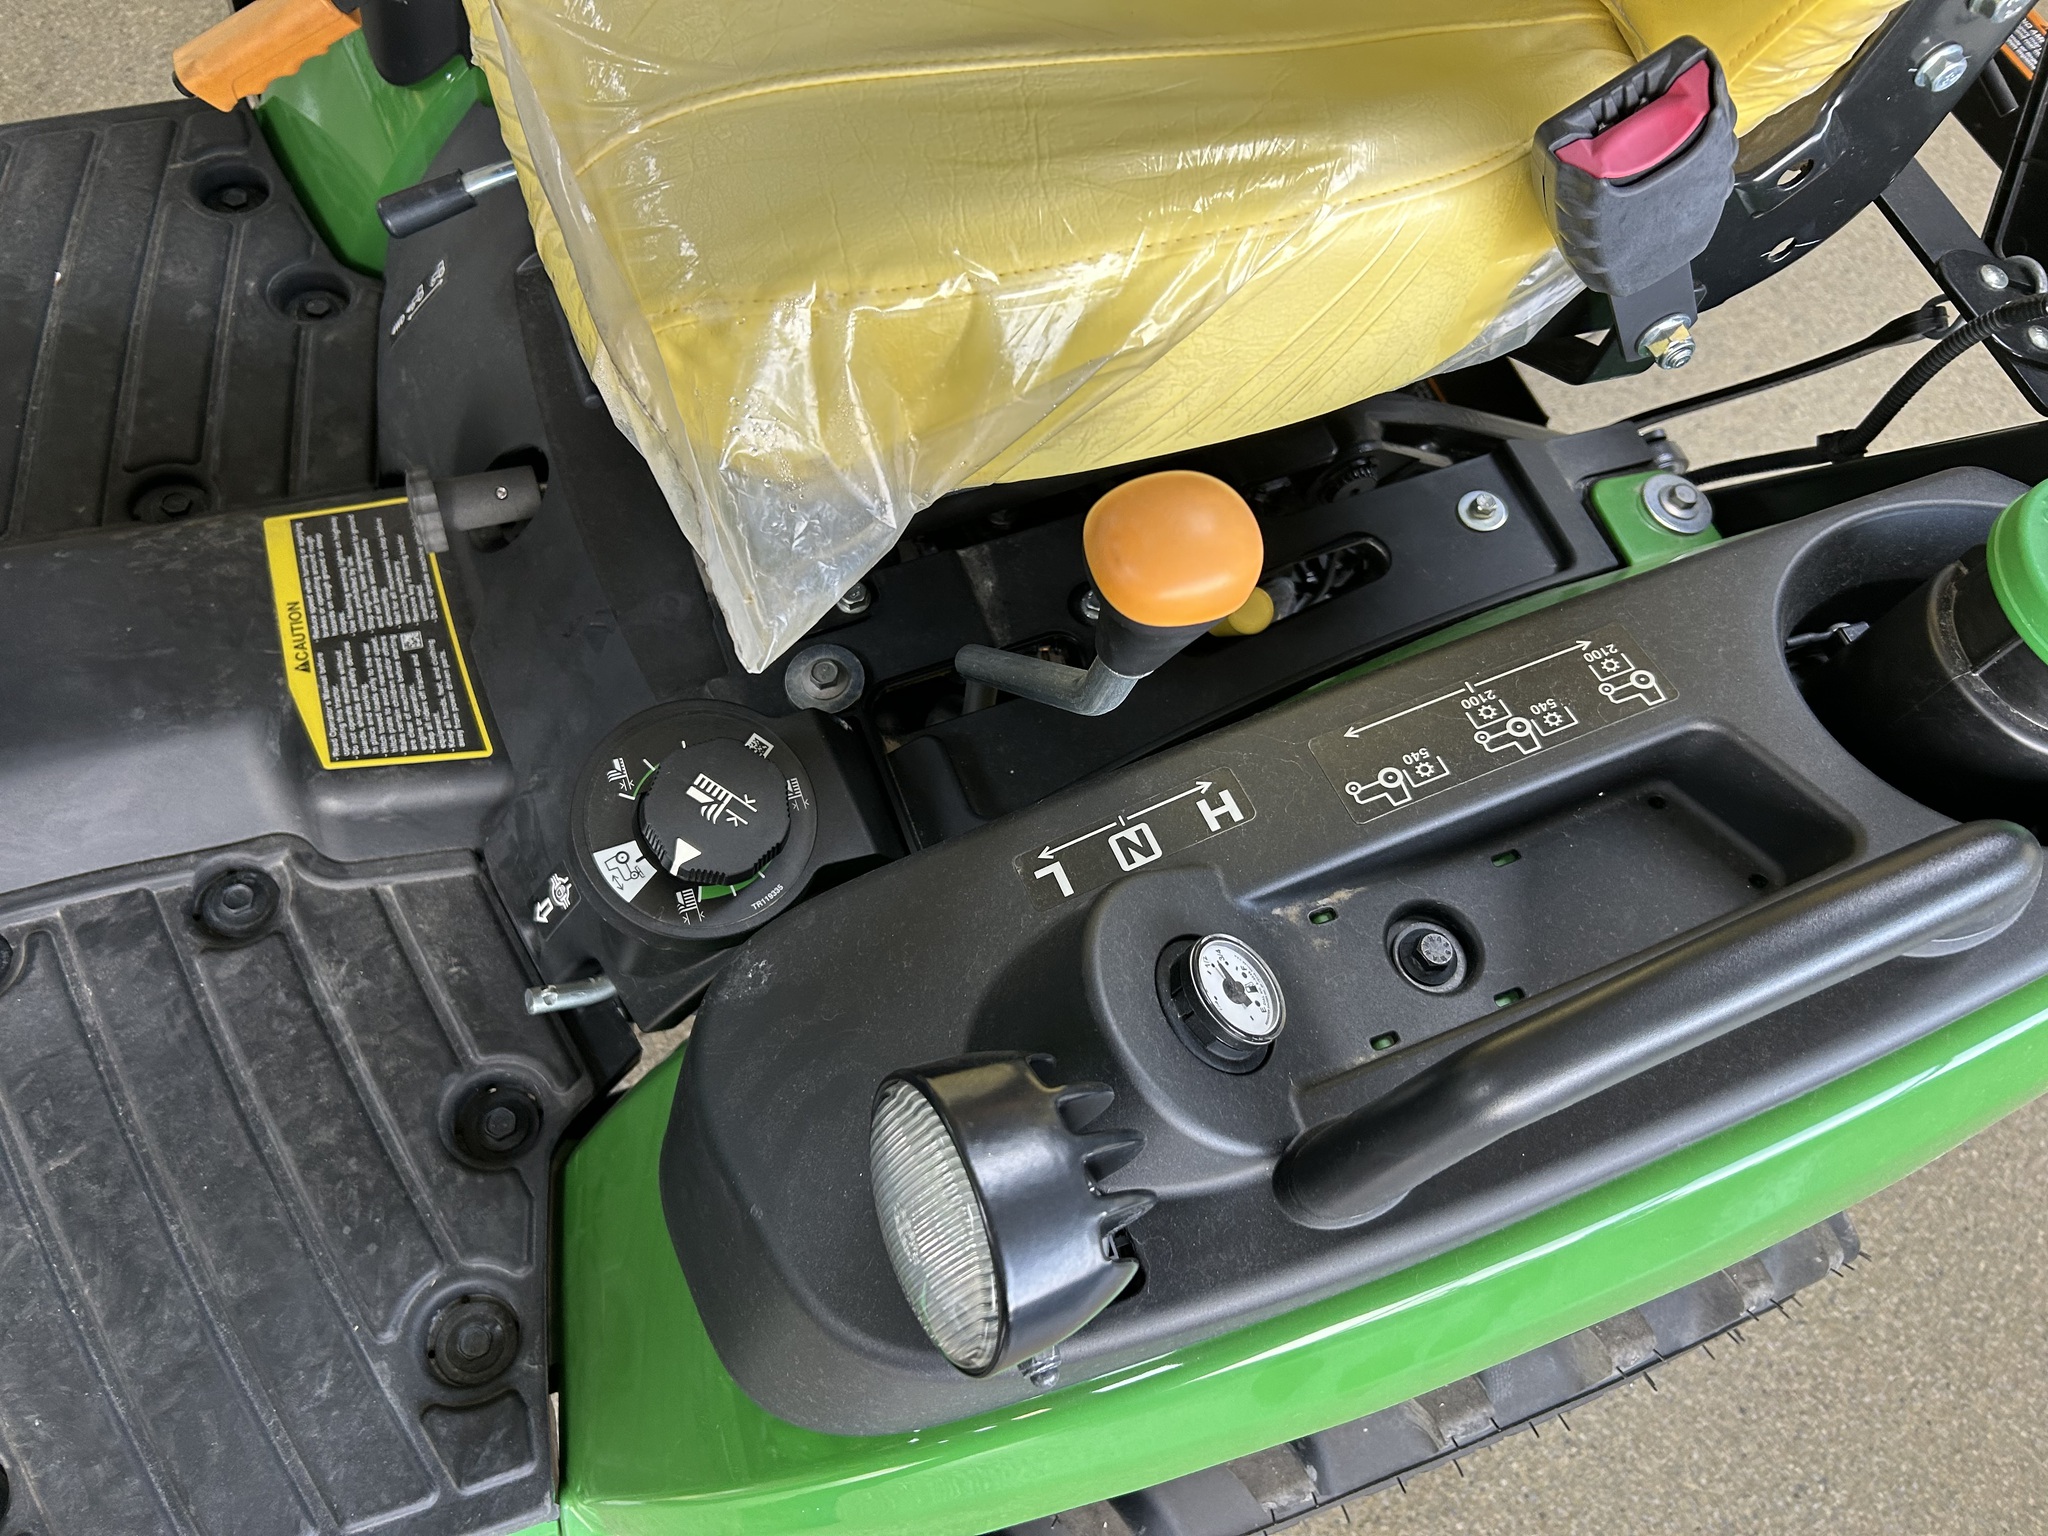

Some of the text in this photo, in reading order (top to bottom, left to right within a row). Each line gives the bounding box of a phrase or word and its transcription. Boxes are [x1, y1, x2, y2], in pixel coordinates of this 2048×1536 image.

[295, 521, 305, 547] applying
[330, 516, 341, 541] highway
[347, 513, 358, 535] ground
[375, 517, 385, 537] before
[305, 535, 315, 554] rough
[315, 532, 324, 550] steep
[379, 536, 388, 551] stop
[300, 554, 310, 577] turning
[308, 553, 319, 576] around
[335, 548, 346, 568] lights
[352, 541, 365, 573] implement
[399, 554, 411, 578] leaving
[417, 546, 428, 573] machine
[318, 557, 331, 581] ground
[339, 567, 350, 593] warning
[382, 558, 396, 591] movement
[304, 577, 313, 594] when
[313, 575, 325, 606] operating
[322, 581, 332, 600] rough
[349, 576, 364, 609] prohibited
[358, 573, 368, 591] lower
[361, 538, 385, 628] and set brake securely before
[406, 584, 418, 596] key
[422, 573, 434, 597] operate
[306, 594, 318, 614] speed
[344, 592, 354, 620] flashing
[389, 591, 398, 600] all
[427, 597, 436, 609] not
[393, 610, 402, 626] Wait
[400, 593, 414, 624] servicing
[409, 596, 420, 623] Remove
[287, 601, 309, 661] CAUTION
[310, 614, 320, 640] Reduce
[320, 614, 330, 638] brakes
[328, 610, 339, 636] hazards
[347, 619, 357, 634] Use
[356, 609, 367, 632] unless
[366, 614, 376, 630] Stop
[343, 640, 354, 667] devices
[362, 642, 371, 657] rear
[380, 635, 390, 657] others
[389, 634, 400, 660] starting
[427, 638, 439, 666] clothing
[1583, 643, 1618, 663] 2100
[316, 652, 326, 674] before
[334, 650, 345, 675] without
[365, 657, 373, 669] the
[374, 656, 386, 687] rearward
[394, 660, 404, 683] before
[432, 666, 442, 680] and
[319, 674, 330, 701] Manual
[347, 667, 358, 688] safety
[368, 677, 378, 692] only
[443, 669, 453, 691] driven
[339, 675, 350, 705] machine
[351, 688, 360, 702] and
[379, 687, 390, 706] avoid
[388, 679, 400, 708] children
[398, 682, 410, 712] machine
[1461, 689, 1496, 710] 2100
[371, 692, 381, 712] loads
[411, 653, 437, 750] Keep all riders off tractor and
[448, 691, 460, 712] power
[1530, 698, 1557, 715] 540
[335, 708, 345, 723] this
[344, 705, 356, 731] operate
[354, 702, 365, 728] shields
[365, 711, 374, 726] and
[374, 712, 385, 734] towed
[385, 716, 397, 734] plate
[393, 708, 405, 732] certain
[443, 719, 452, 729] all
[452, 712, 461, 729] from
[338, 722, 352, 756] operating
[349, 731, 358, 744] not
[368, 726, 380, 746] place
[406, 721, 415, 739] clear
[417, 726, 429, 751] engine
[446, 729, 456, 749] Keep
[456, 729, 466, 748] away
[330, 737, 340, 758] Read
[379, 734, 389, 754] Hitch
[388, 734, 399, 753] hitch
[398, 732, 408, 752] Make
[409, 739, 418, 751] are
[1402, 747, 1430, 765] 540
[1034, 789, 1244, 897] L N H
[751, 883, 784, 910] TR119335
